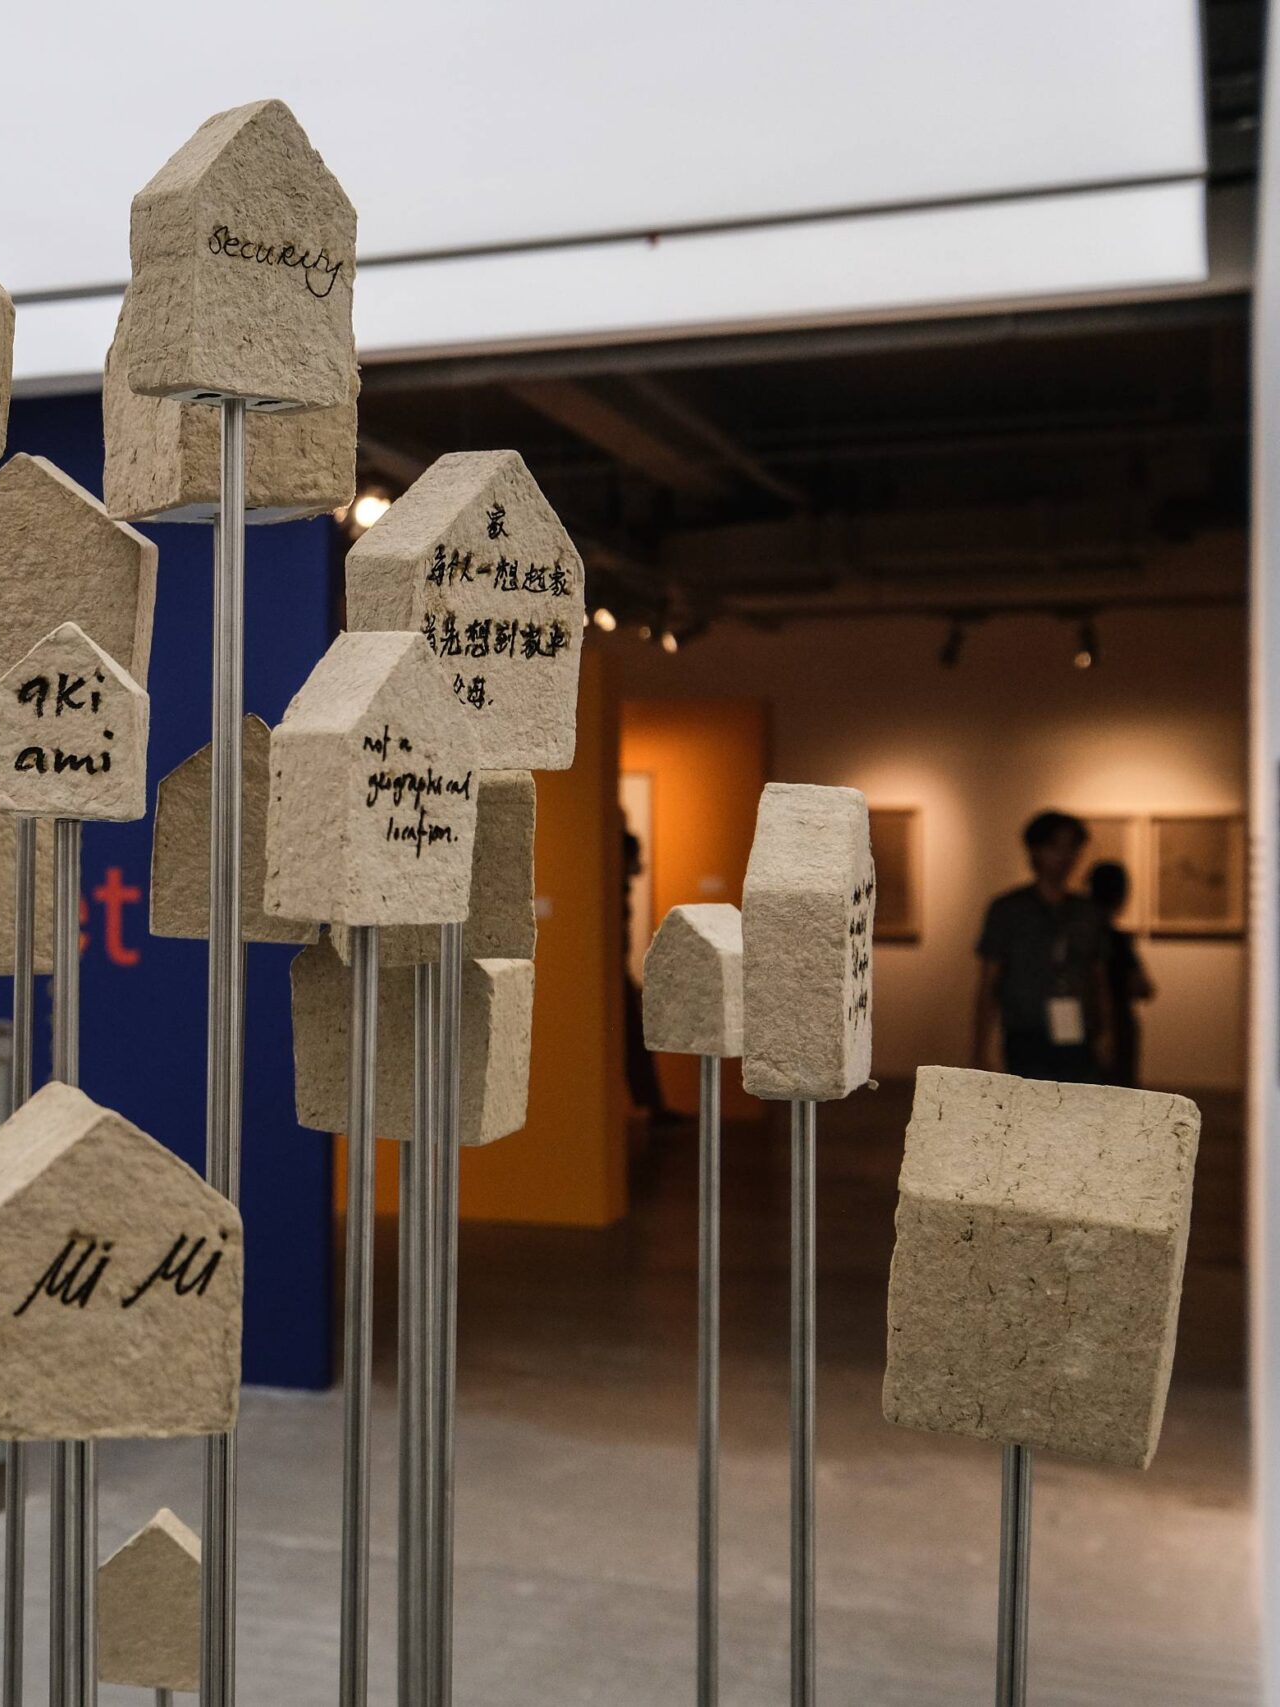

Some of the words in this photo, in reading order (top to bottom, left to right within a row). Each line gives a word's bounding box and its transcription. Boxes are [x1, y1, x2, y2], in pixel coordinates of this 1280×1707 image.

[14, 730, 114, 776] ami
[363, 724, 392, 762] not
[399, 737, 412, 752] a
[366, 767, 472, 811] geographical
